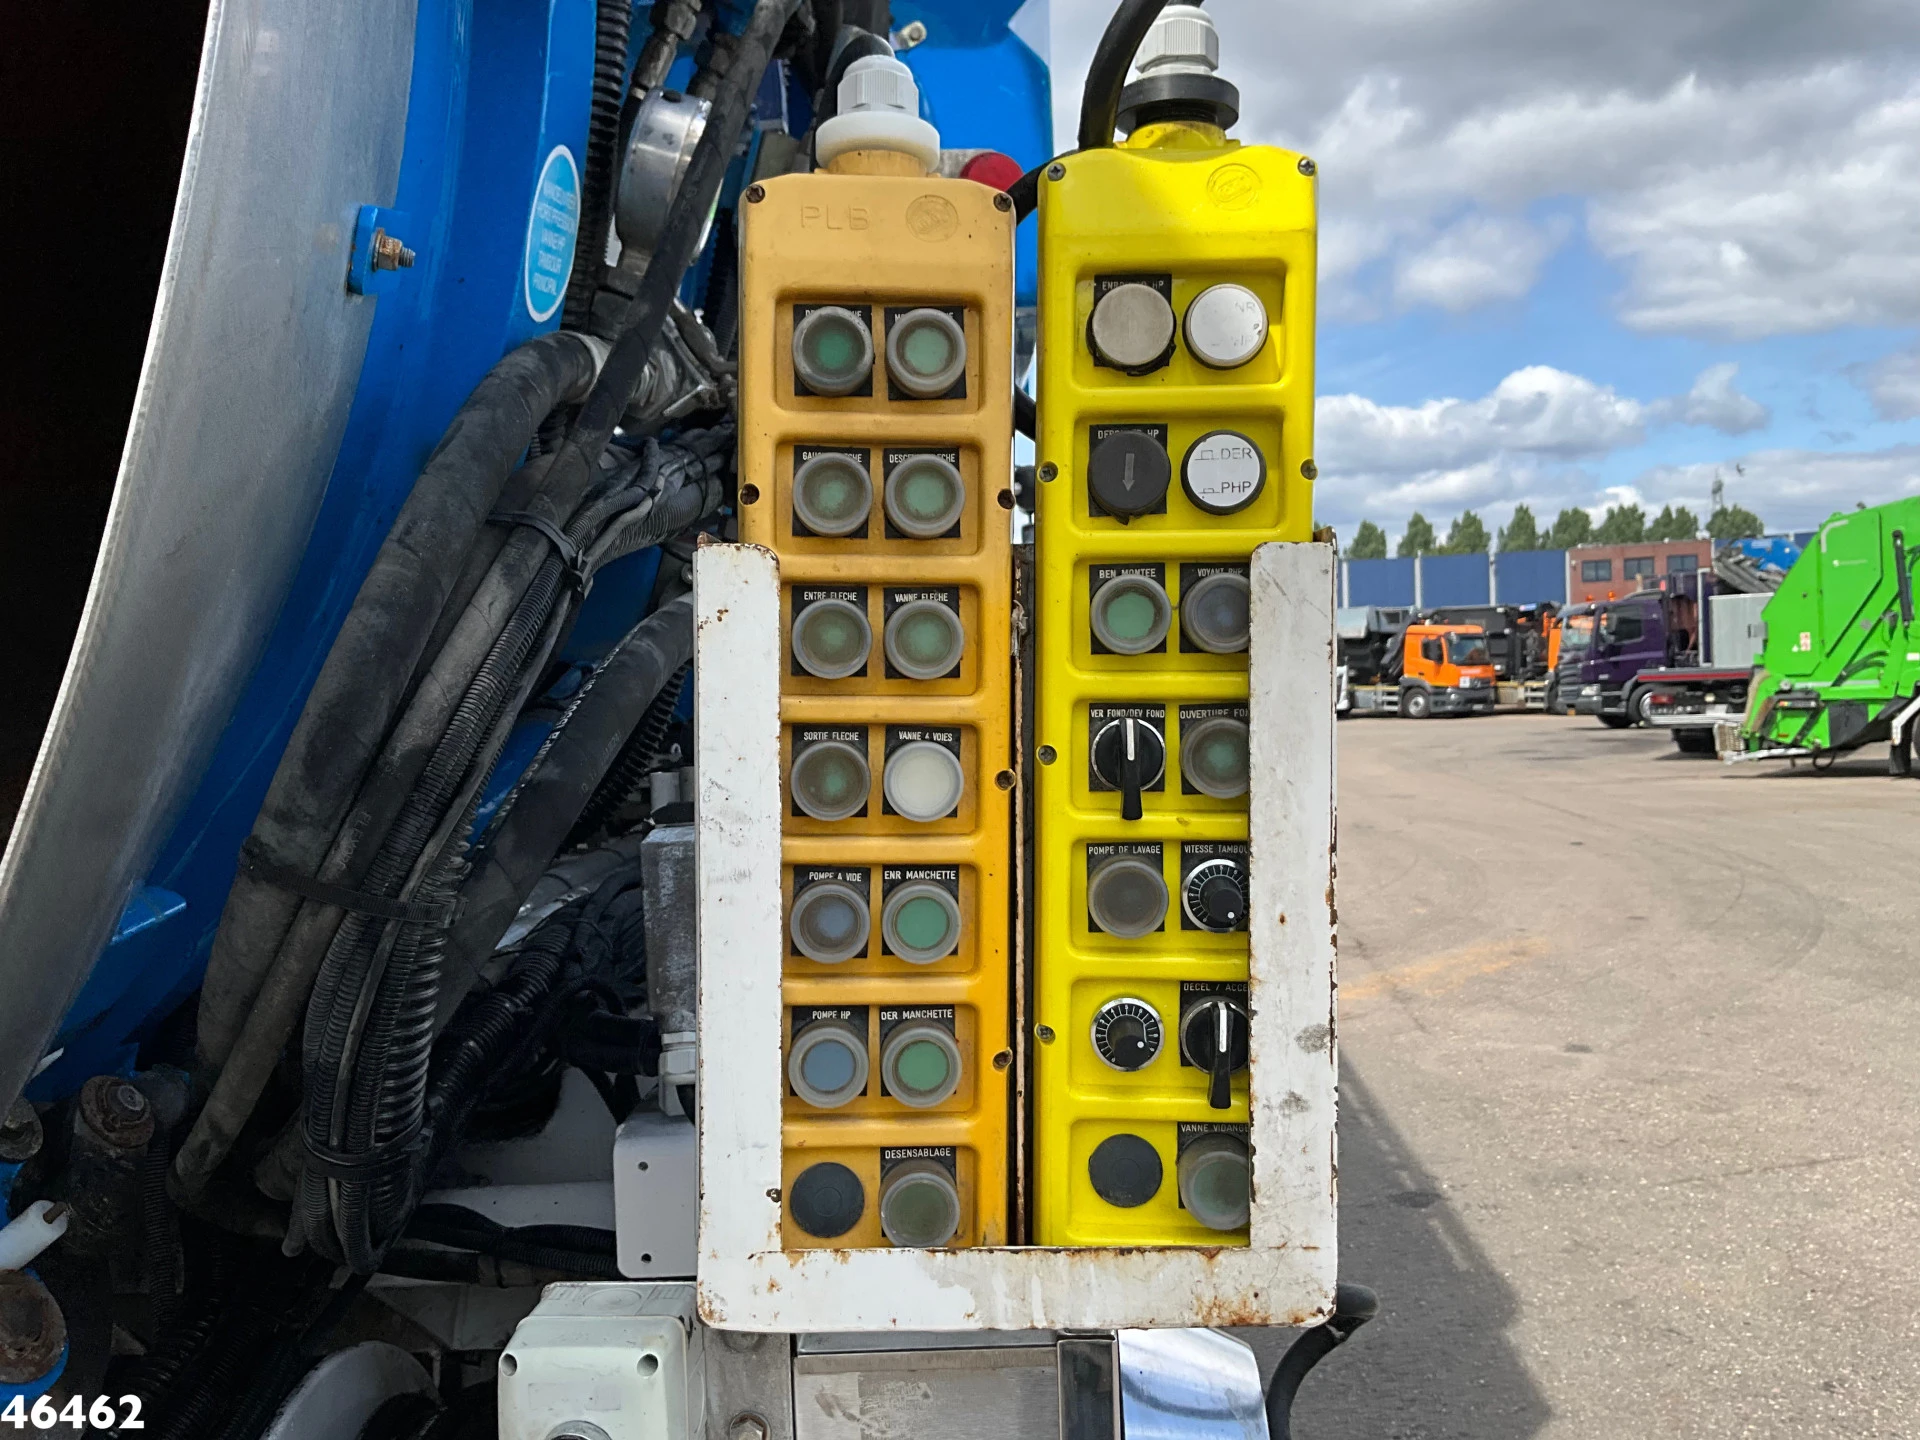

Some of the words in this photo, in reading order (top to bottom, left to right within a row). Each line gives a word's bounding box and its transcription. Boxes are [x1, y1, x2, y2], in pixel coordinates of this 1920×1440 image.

[1221, 447, 1252, 459] DER
[1221, 481, 1251, 493] PHP
[1099, 569, 1116, 578] BEN
[804, 591, 826, 600] ENTRE
[894, 593, 917, 602] VANNE
[1090, 709, 1104, 718] VER
[1146, 709, 1165, 718] FOND
[803, 731, 828, 741] SORTIE
[832, 731, 859, 740] FLECHE
[898, 731, 922, 740] VANNE
[932, 732, 953, 742] VOIES
[1089, 845, 1115, 855] POMPE
[1118, 845, 1130, 854] DE
[1132, 844, 1161, 854] LAVAGE
[1184, 844, 1213, 854] VITESSE
[808, 871, 834, 880] POMPE
[837, 872, 843, 880] A
[845, 872, 862, 881] VIDE
[884, 870, 902, 880] ENR
[906, 870, 956, 879] MANCHETTE
[1183, 982, 1211, 991] DECEL
[812, 1010, 837, 1019] POMPE
[840, 1010, 851, 1019] HP
[880, 1011, 898, 1020] DER
[902, 1009, 953, 1020] MANCHETTE
[1180, 1123, 1209, 1133] VANNE
[884, 1147, 951, 1159] DESENSABLAGE
